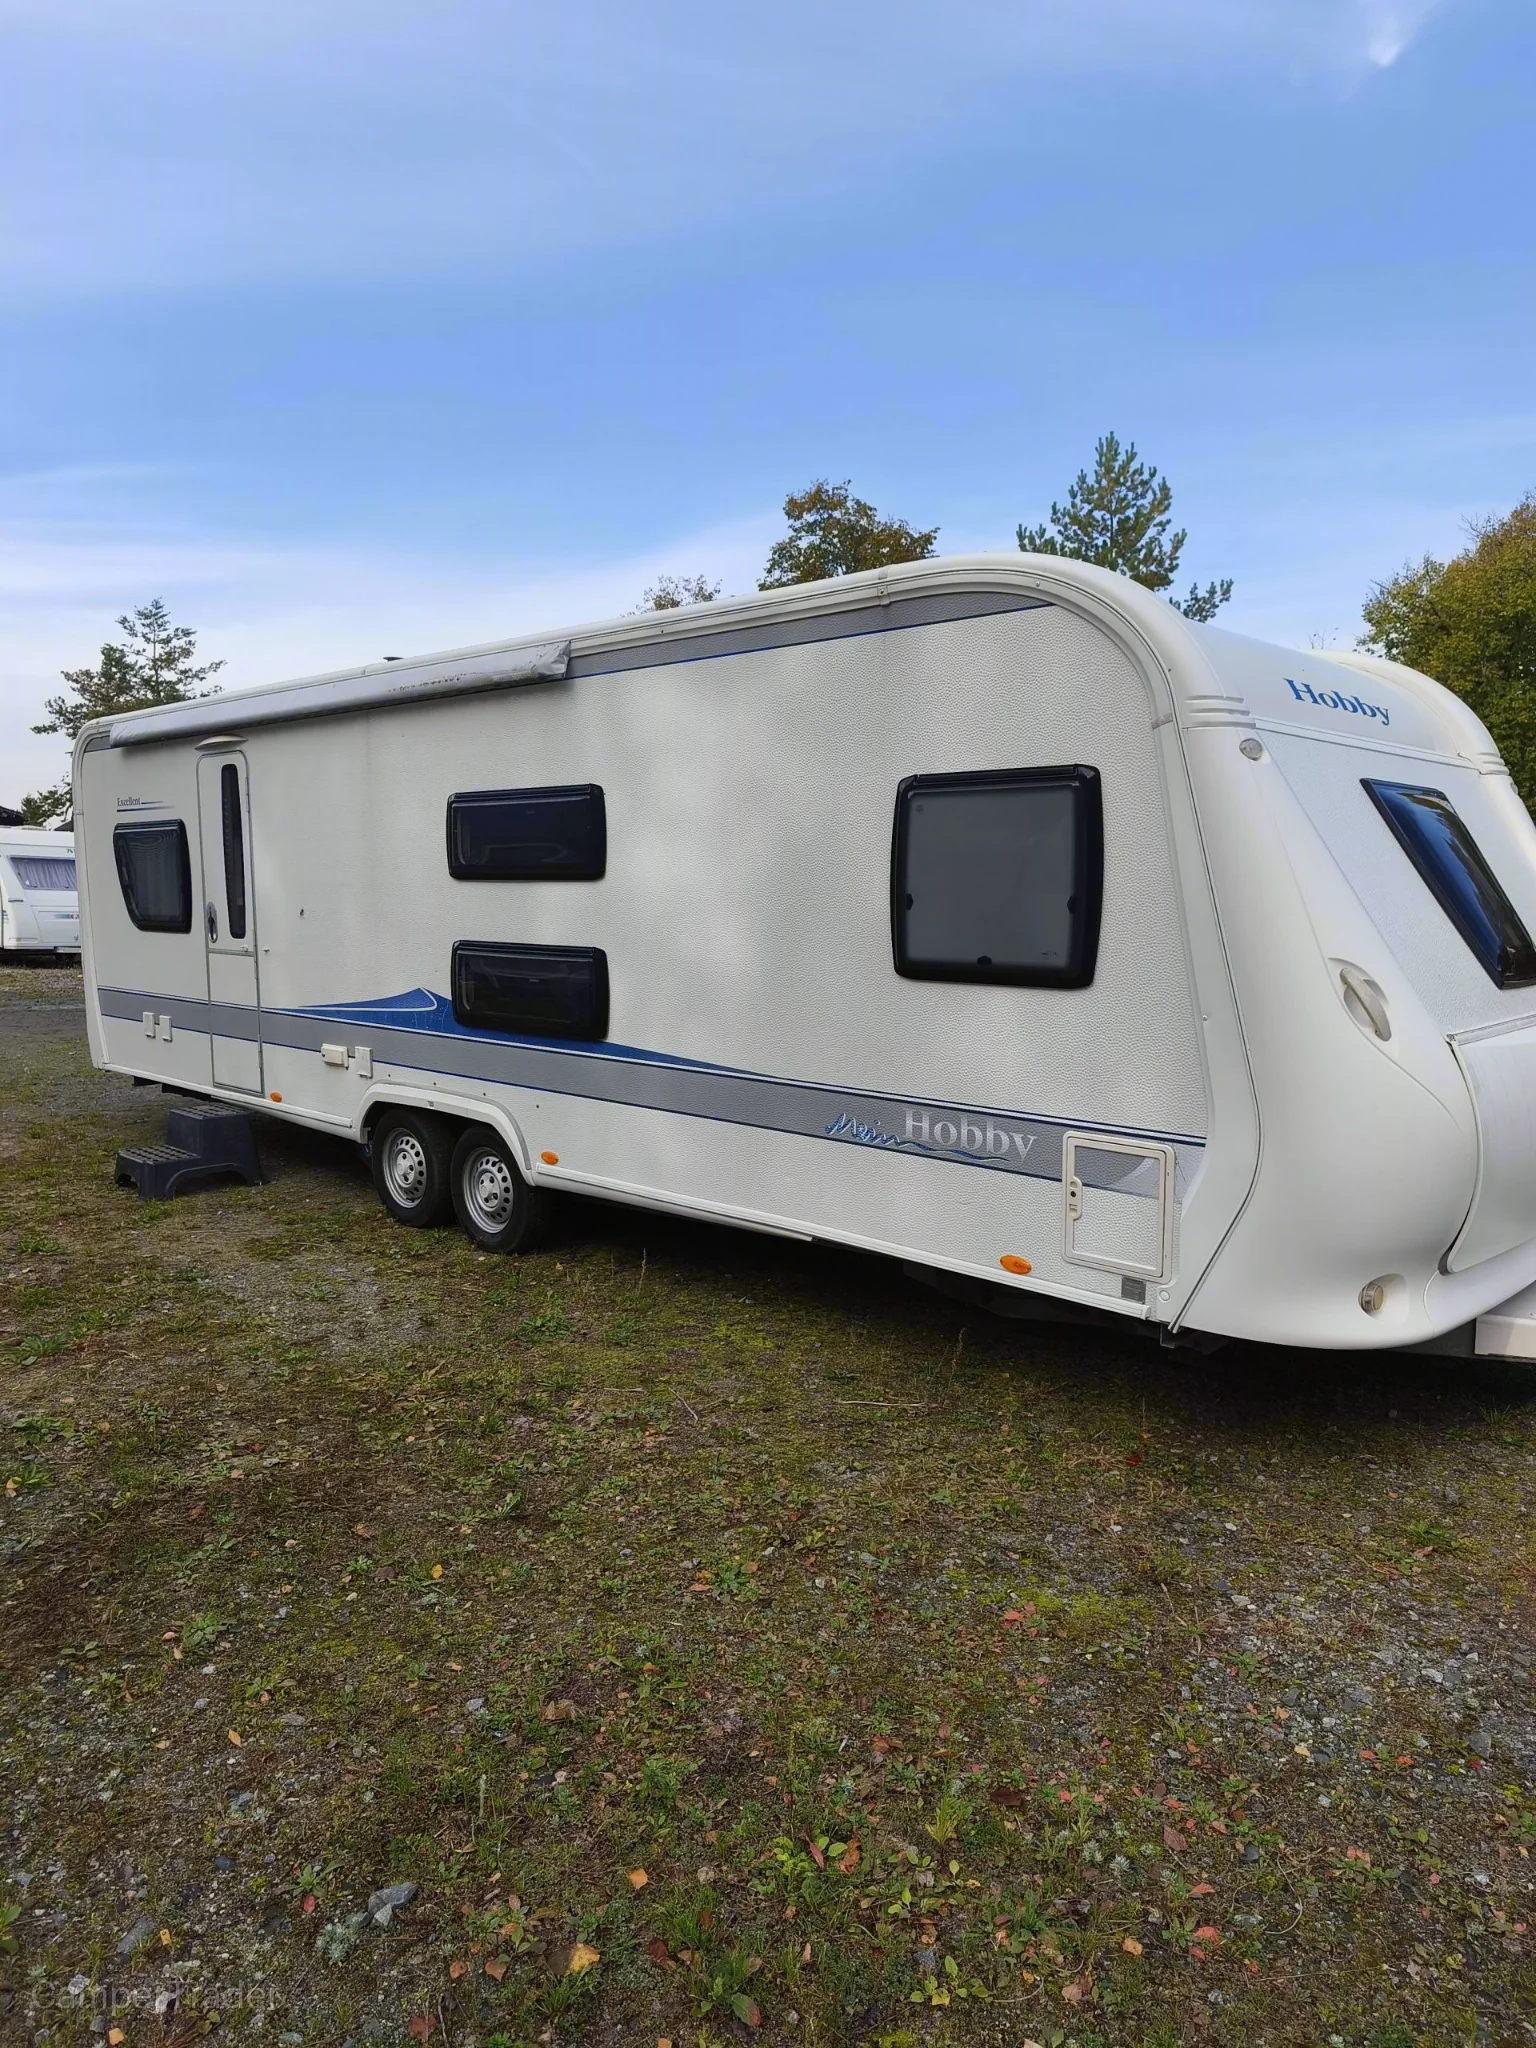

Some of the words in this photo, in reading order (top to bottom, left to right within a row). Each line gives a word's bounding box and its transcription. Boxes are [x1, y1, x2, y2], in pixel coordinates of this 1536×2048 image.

[1281, 677, 1390, 726] Hobby
[116, 796, 141, 807] Excellent
[904, 1109, 1037, 1161] Hobby
